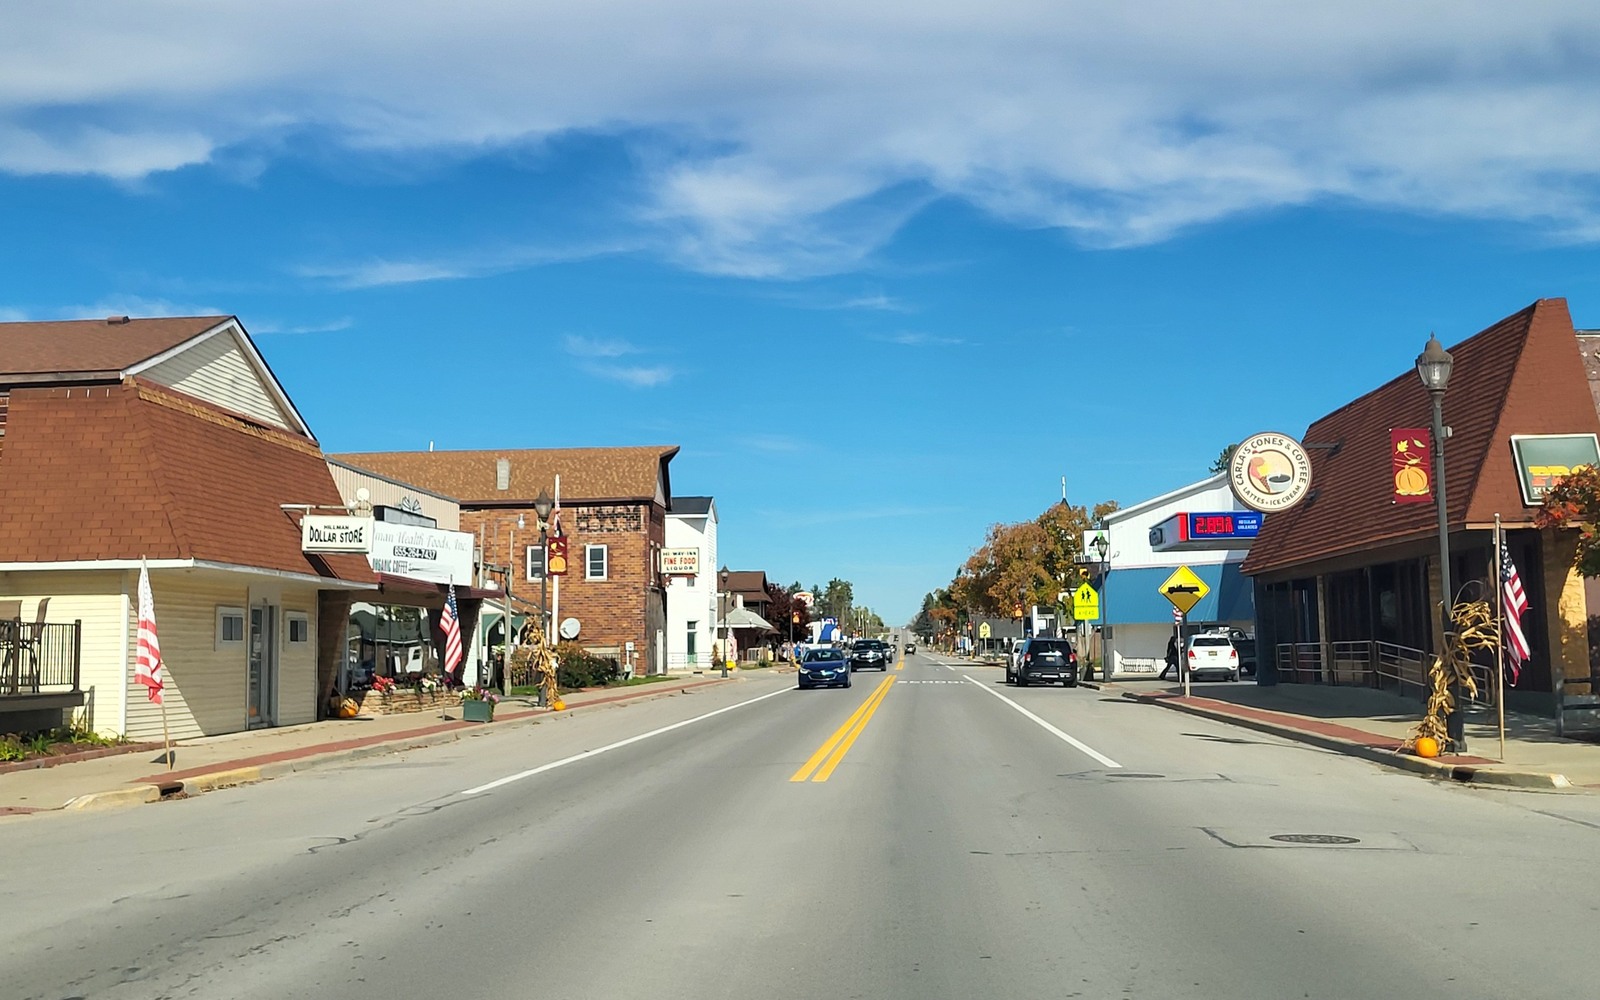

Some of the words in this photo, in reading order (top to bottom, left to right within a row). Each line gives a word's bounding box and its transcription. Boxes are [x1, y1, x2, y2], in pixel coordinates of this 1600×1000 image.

[1235, 446, 1251, 486] CARLA'S
[1250, 437, 1284, 449] CONES
[1291, 448, 1307, 484] COFFEE
[1242, 486, 1265, 505] LATTES
[1281, 485, 1302, 503] CREAM
[309, 525, 336, 542] DOLLAR
[339, 526, 363, 543] STORE
[392, 560, 408, 574] COFFEE
[664, 557, 677, 565] FINE
[679, 557, 696, 565] FOOD
